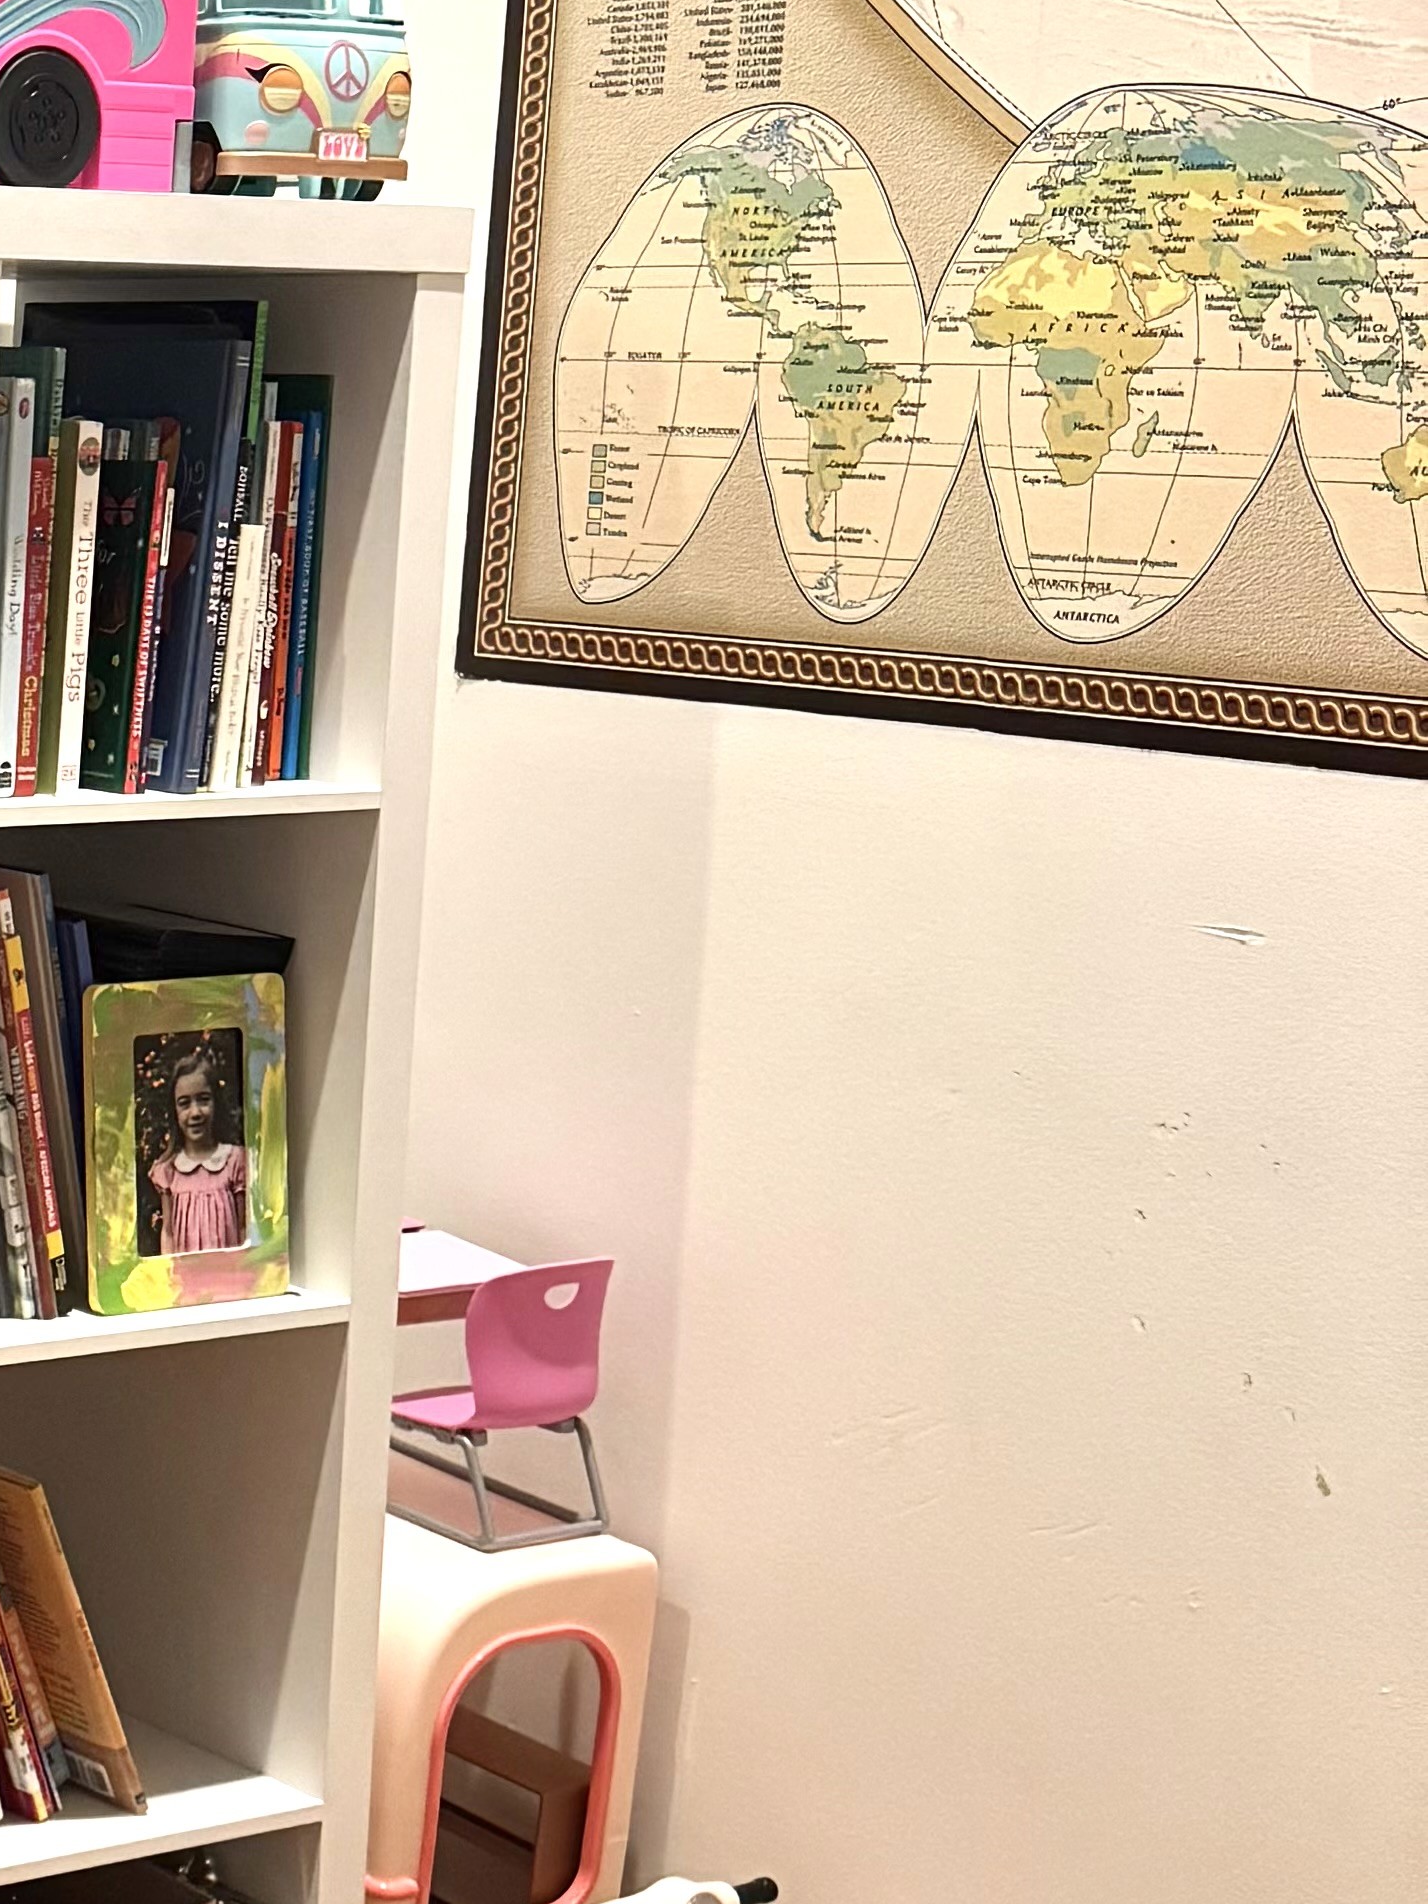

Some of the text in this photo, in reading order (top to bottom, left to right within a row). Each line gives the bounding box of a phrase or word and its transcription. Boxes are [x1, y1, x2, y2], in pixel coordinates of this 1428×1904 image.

[1211, 189, 1289, 201] ASIA
[1052, 207, 1099, 217] EUROPE
[720, 248, 785, 259] AMERICA
[1320, 248, 1352, 257] Wuhan
[1029, 323, 1130, 334] AFRICA
[826, 383, 873, 394] SOUTH
[817, 400, 879, 413] AMERICA
[233, 465, 249, 522] BONSALL
[7, 535, 24, 635] Wedding Day!
[207, 536, 227, 626] DISSENT
[222, 572, 237, 597] me
[65, 501, 93, 702] The Three Little Pigs
[217, 601, 232, 646] some
[1054, 610, 1120, 625] ANTARCTICA
[21, 676, 37, 757] Christmas
[38, 1150, 50, 1187] AFRICAN
[44, 1190, 56, 1228] ANIMALS
